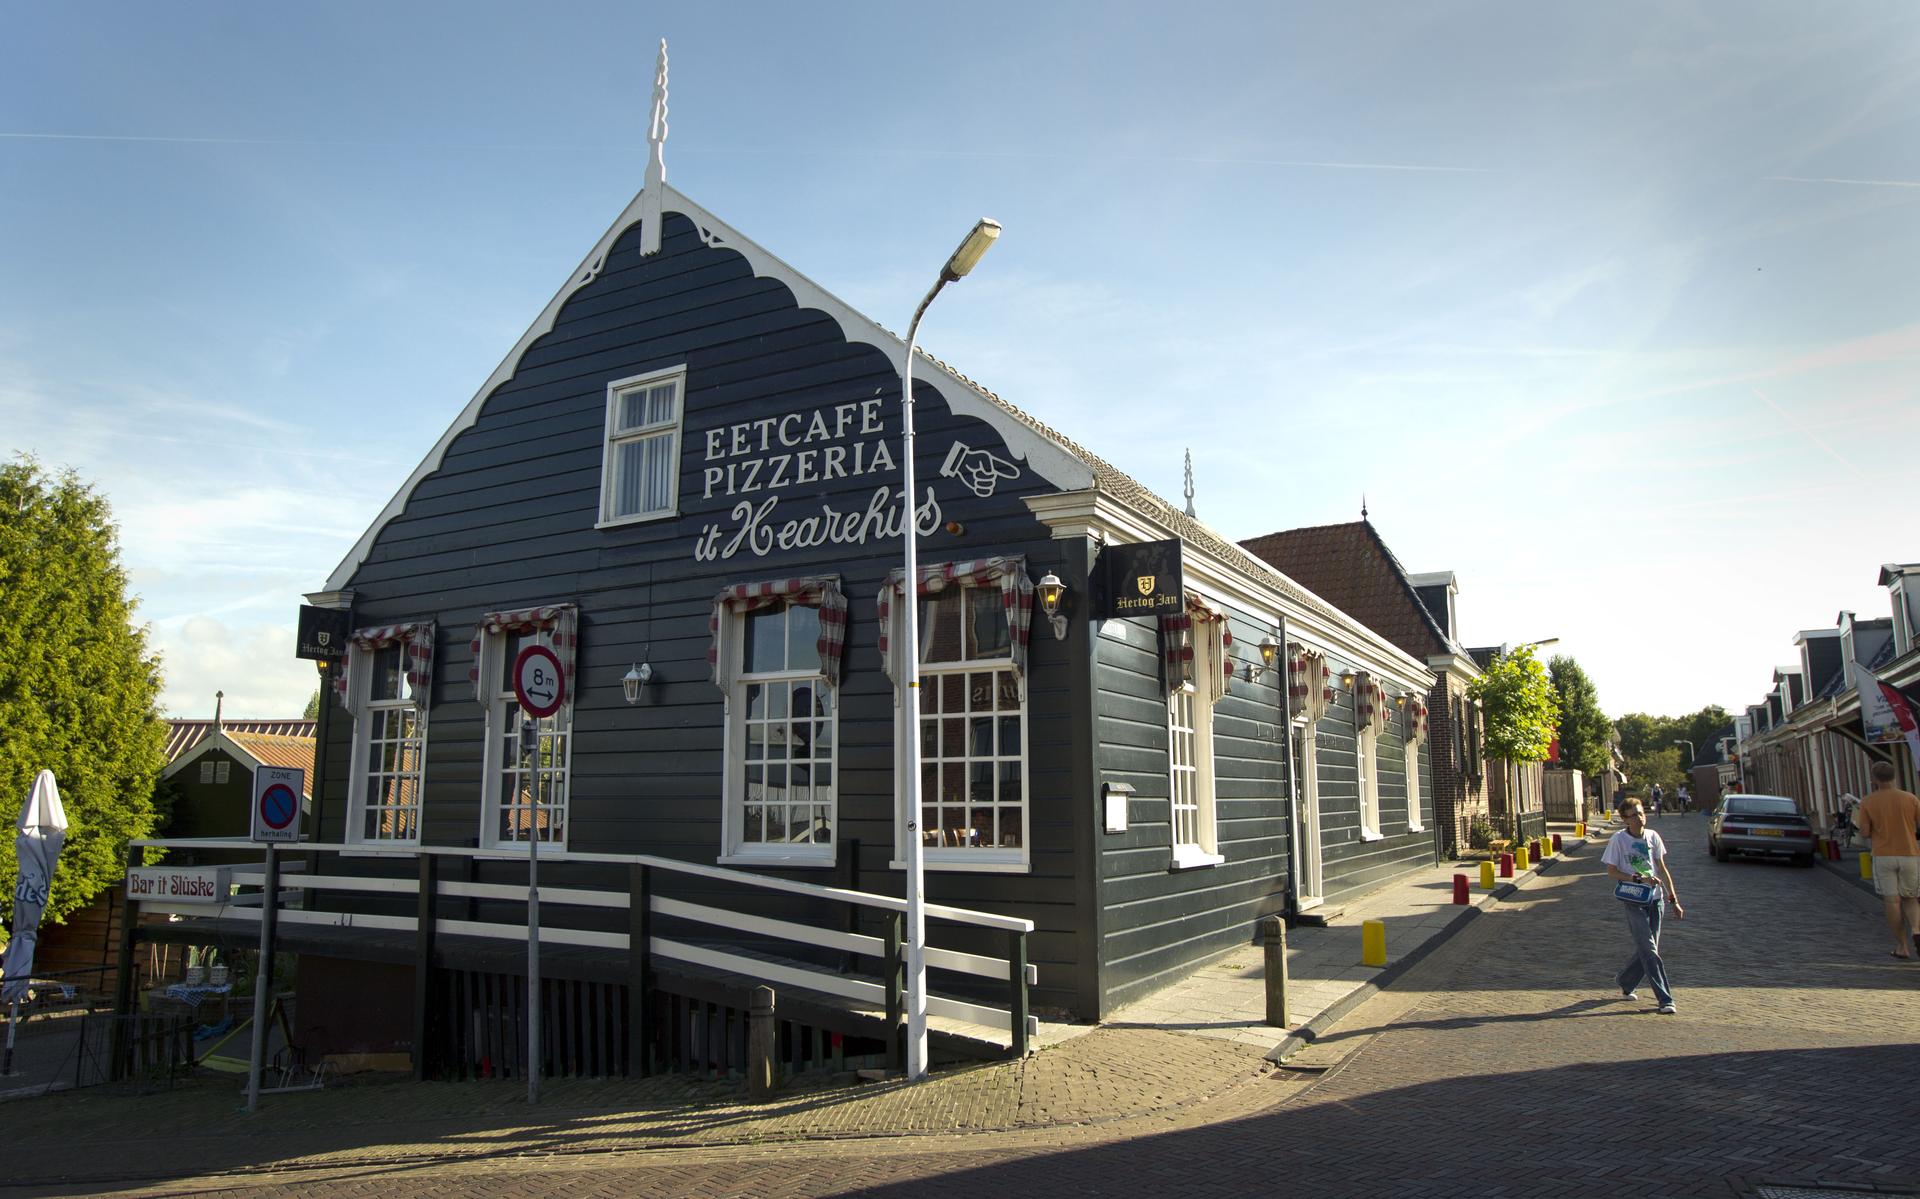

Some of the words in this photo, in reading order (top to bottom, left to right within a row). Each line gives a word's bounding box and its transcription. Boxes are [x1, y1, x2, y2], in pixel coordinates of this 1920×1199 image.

[704, 388, 884, 461] EETCAFÉ
[703, 439, 896, 499] PIZZERIA
[694, 523, 722, 561] it
[1116, 596, 1154, 609] Hertog
[1156, 594, 1178, 606] Jan
[302, 643, 328, 656] Hertog
[533, 668, 544, 686] 8
[545, 677, 554, 687] m
[270, 771, 292, 780] ZONE
[260, 830, 292, 840] herhaling
[130, 874, 154, 894] Bar
[158, 875, 167, 895] it
[171, 875, 215, 897] Slûske
